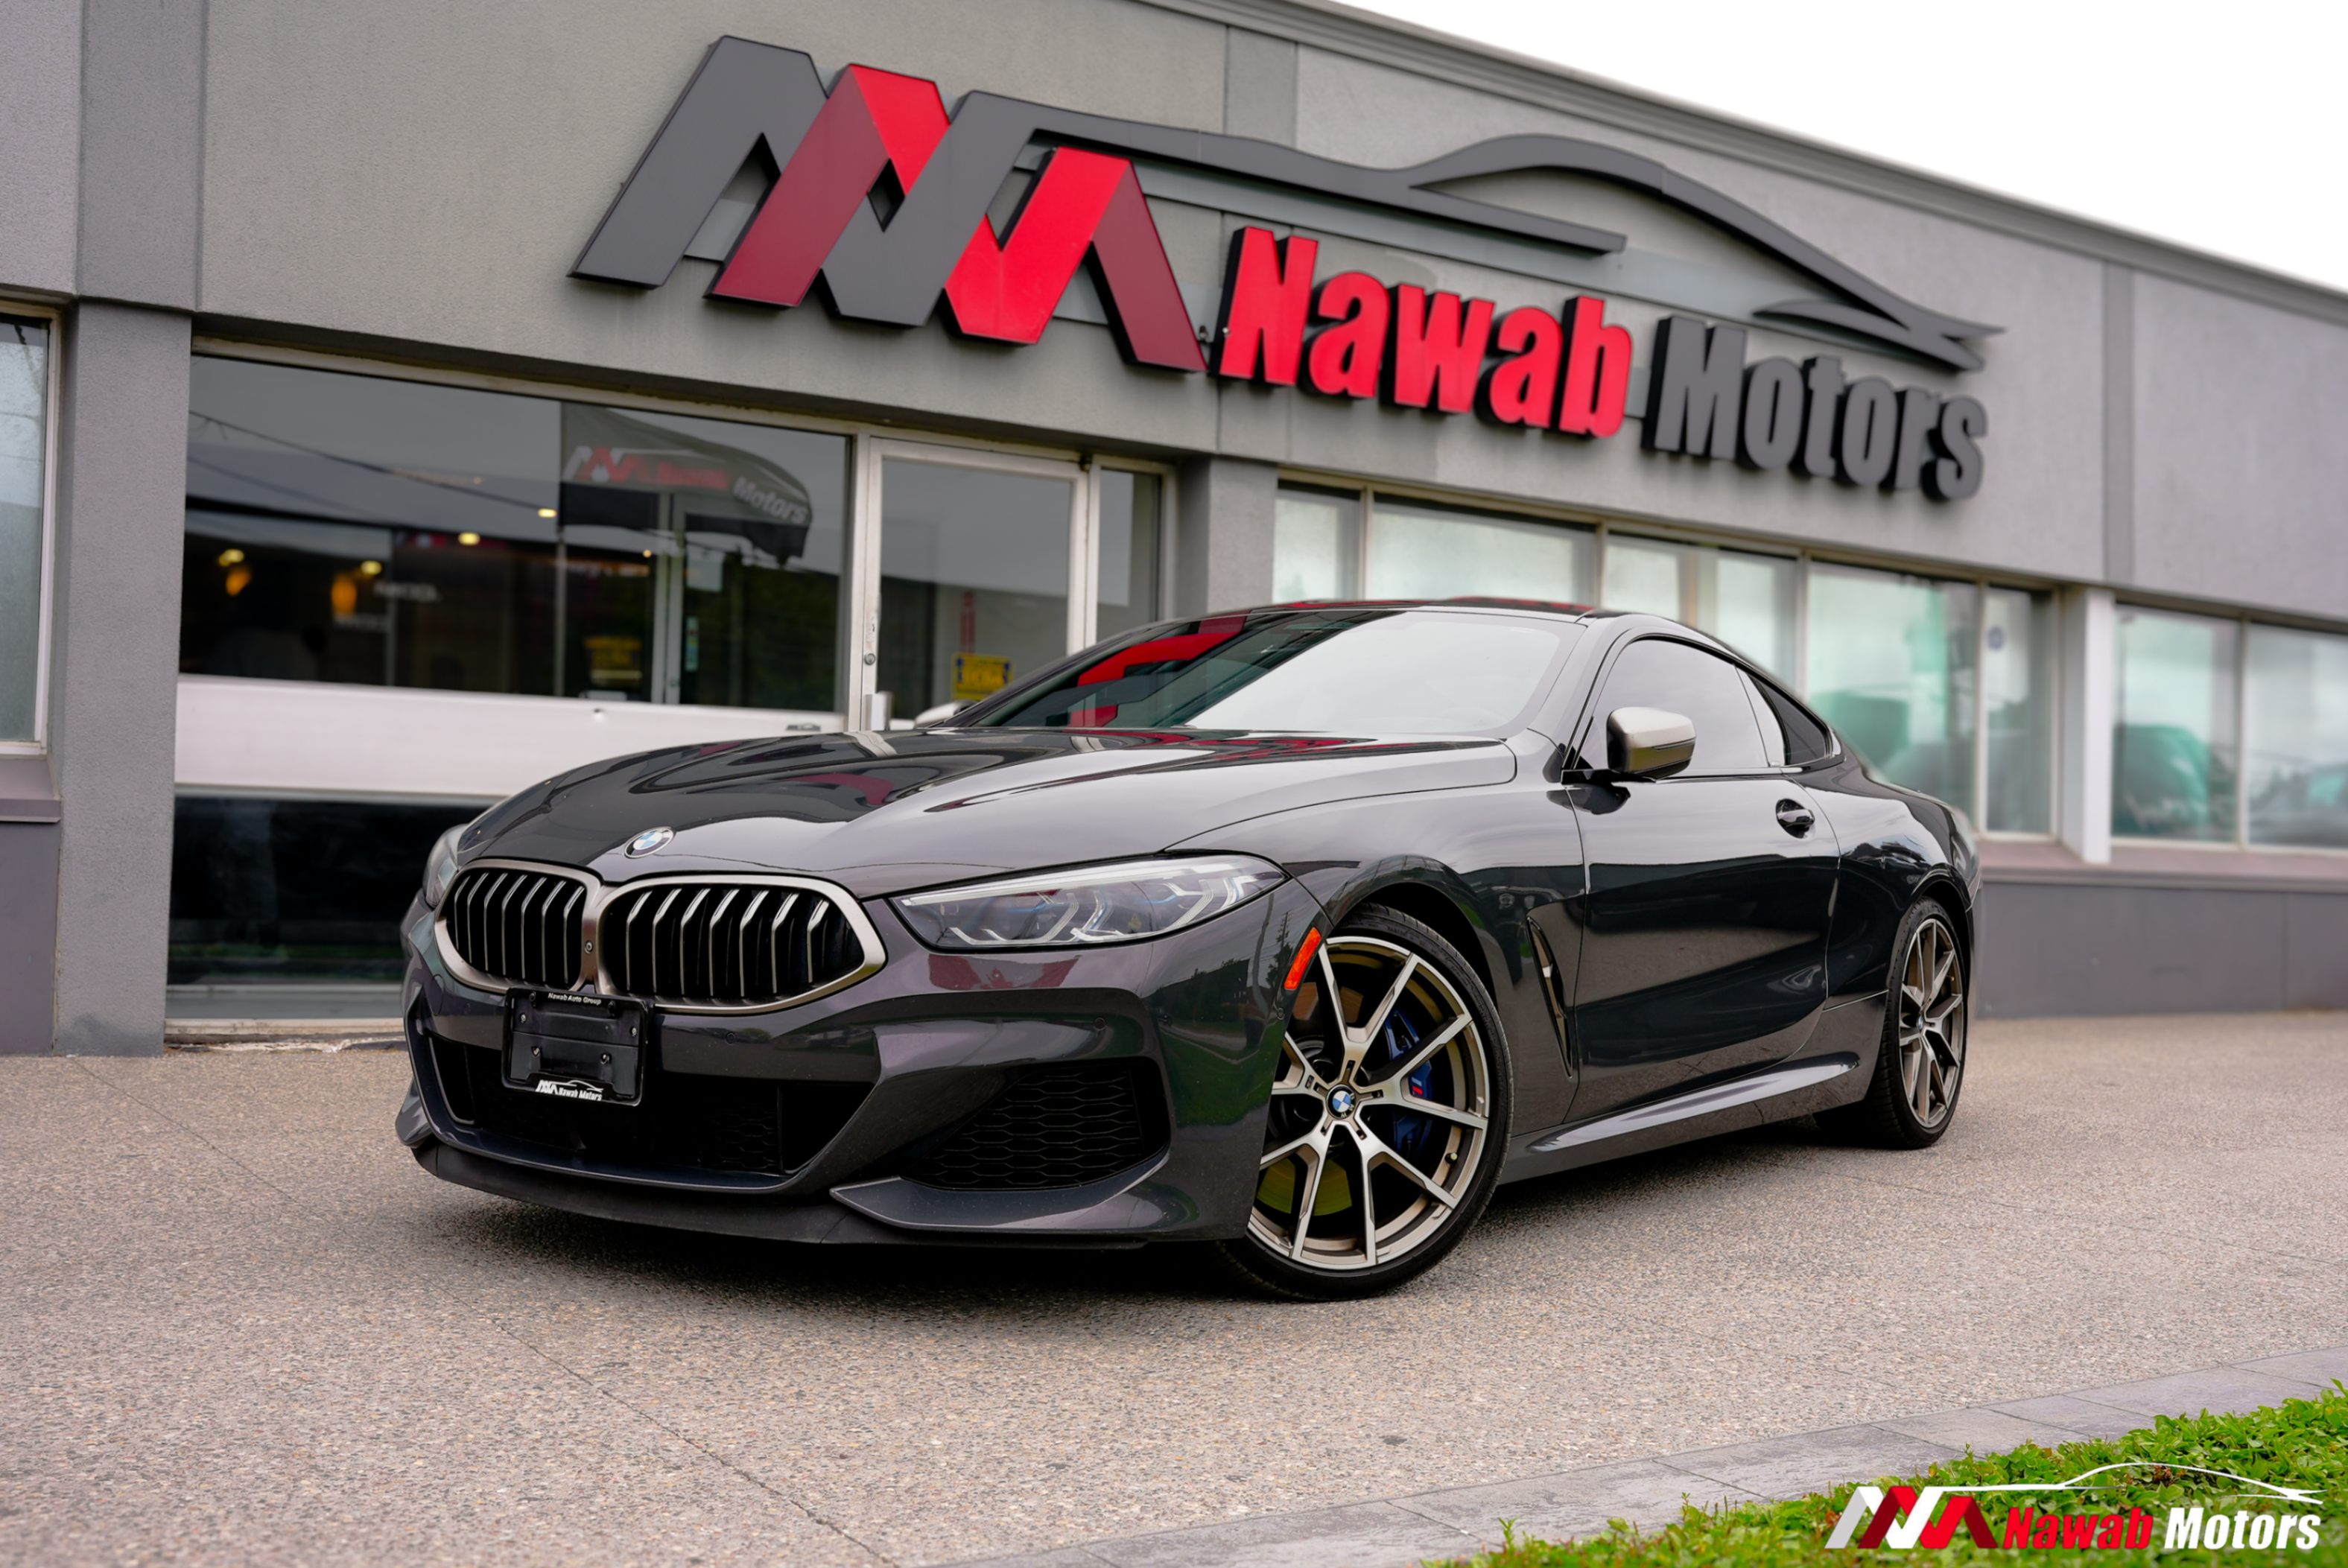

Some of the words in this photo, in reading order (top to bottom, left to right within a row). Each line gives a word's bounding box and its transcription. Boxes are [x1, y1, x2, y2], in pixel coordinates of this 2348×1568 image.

[1219, 226, 1634, 439] Nawab
[1646, 315, 1987, 500] Motors
[734, 477, 807, 524] Motors
[548, 992, 567, 1001] Nawab
[583, 997, 602, 1006] Group
[579, 1090, 603, 1101] Motors
